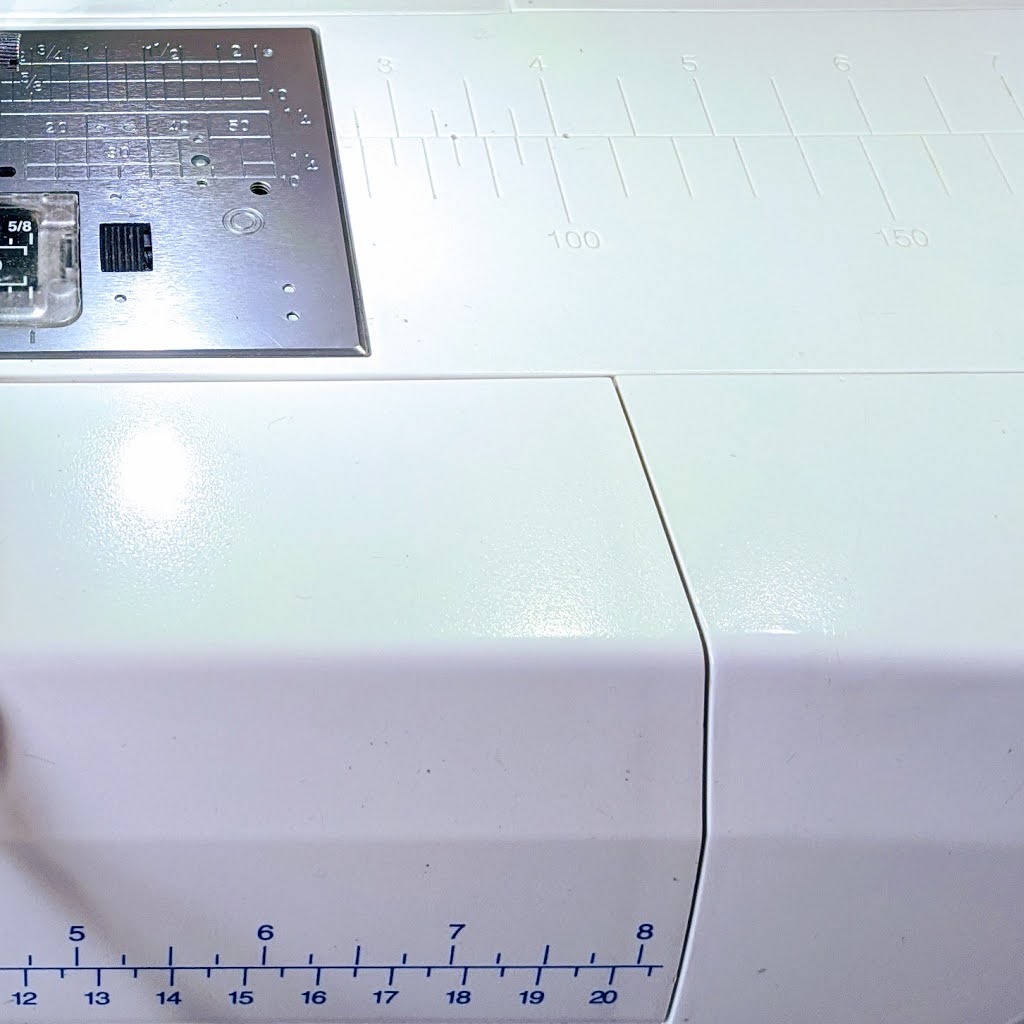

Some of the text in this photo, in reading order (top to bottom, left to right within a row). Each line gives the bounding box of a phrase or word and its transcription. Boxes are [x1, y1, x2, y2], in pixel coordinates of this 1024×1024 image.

[7, 220, 33, 232] 5/8
[546, 229, 601, 249] 100
[68, 925, 86, 942] 5
[256, 924, 275, 941] 6
[448, 923, 467, 940] 7
[635, 923, 654, 941] 8
[11, 991, 38, 1006] 12
[83, 991, 111, 1006] 13
[155, 990, 183, 1006] 14
[228, 990, 255, 1006] 15
[300, 990, 327, 1005] 16
[372, 990, 400, 1005] 17
[445, 990, 472, 1005] 18
[518, 990, 545, 1005] 19
[588, 989, 618, 1005] 20
